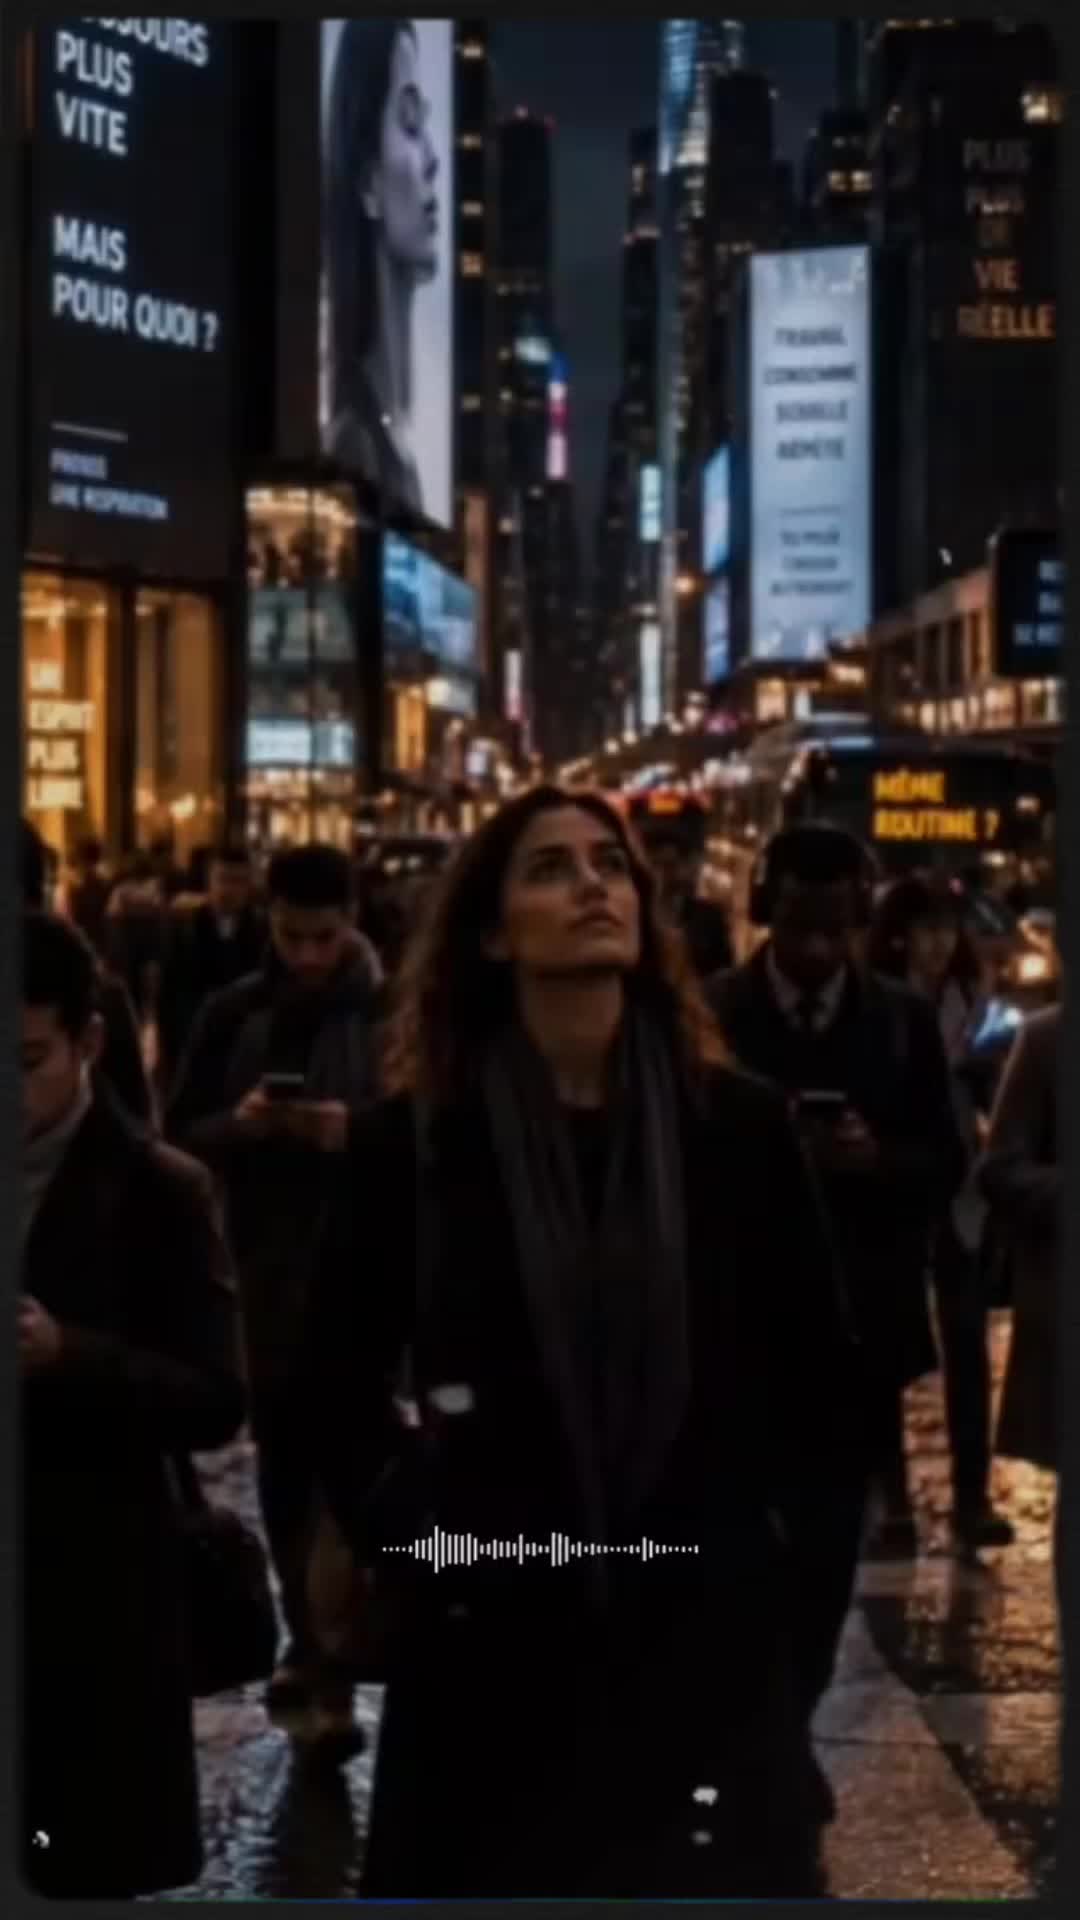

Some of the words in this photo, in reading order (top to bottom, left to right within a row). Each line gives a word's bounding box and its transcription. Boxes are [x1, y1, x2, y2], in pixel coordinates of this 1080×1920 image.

[55, 29, 133, 97] PLUS
[55, 90, 128, 156] VITE
[52, 213, 126, 272] MAIS
[52, 272, 130, 333] POUR
[134, 293, 197, 348] QUOI
[201, 311, 218, 352] ?
